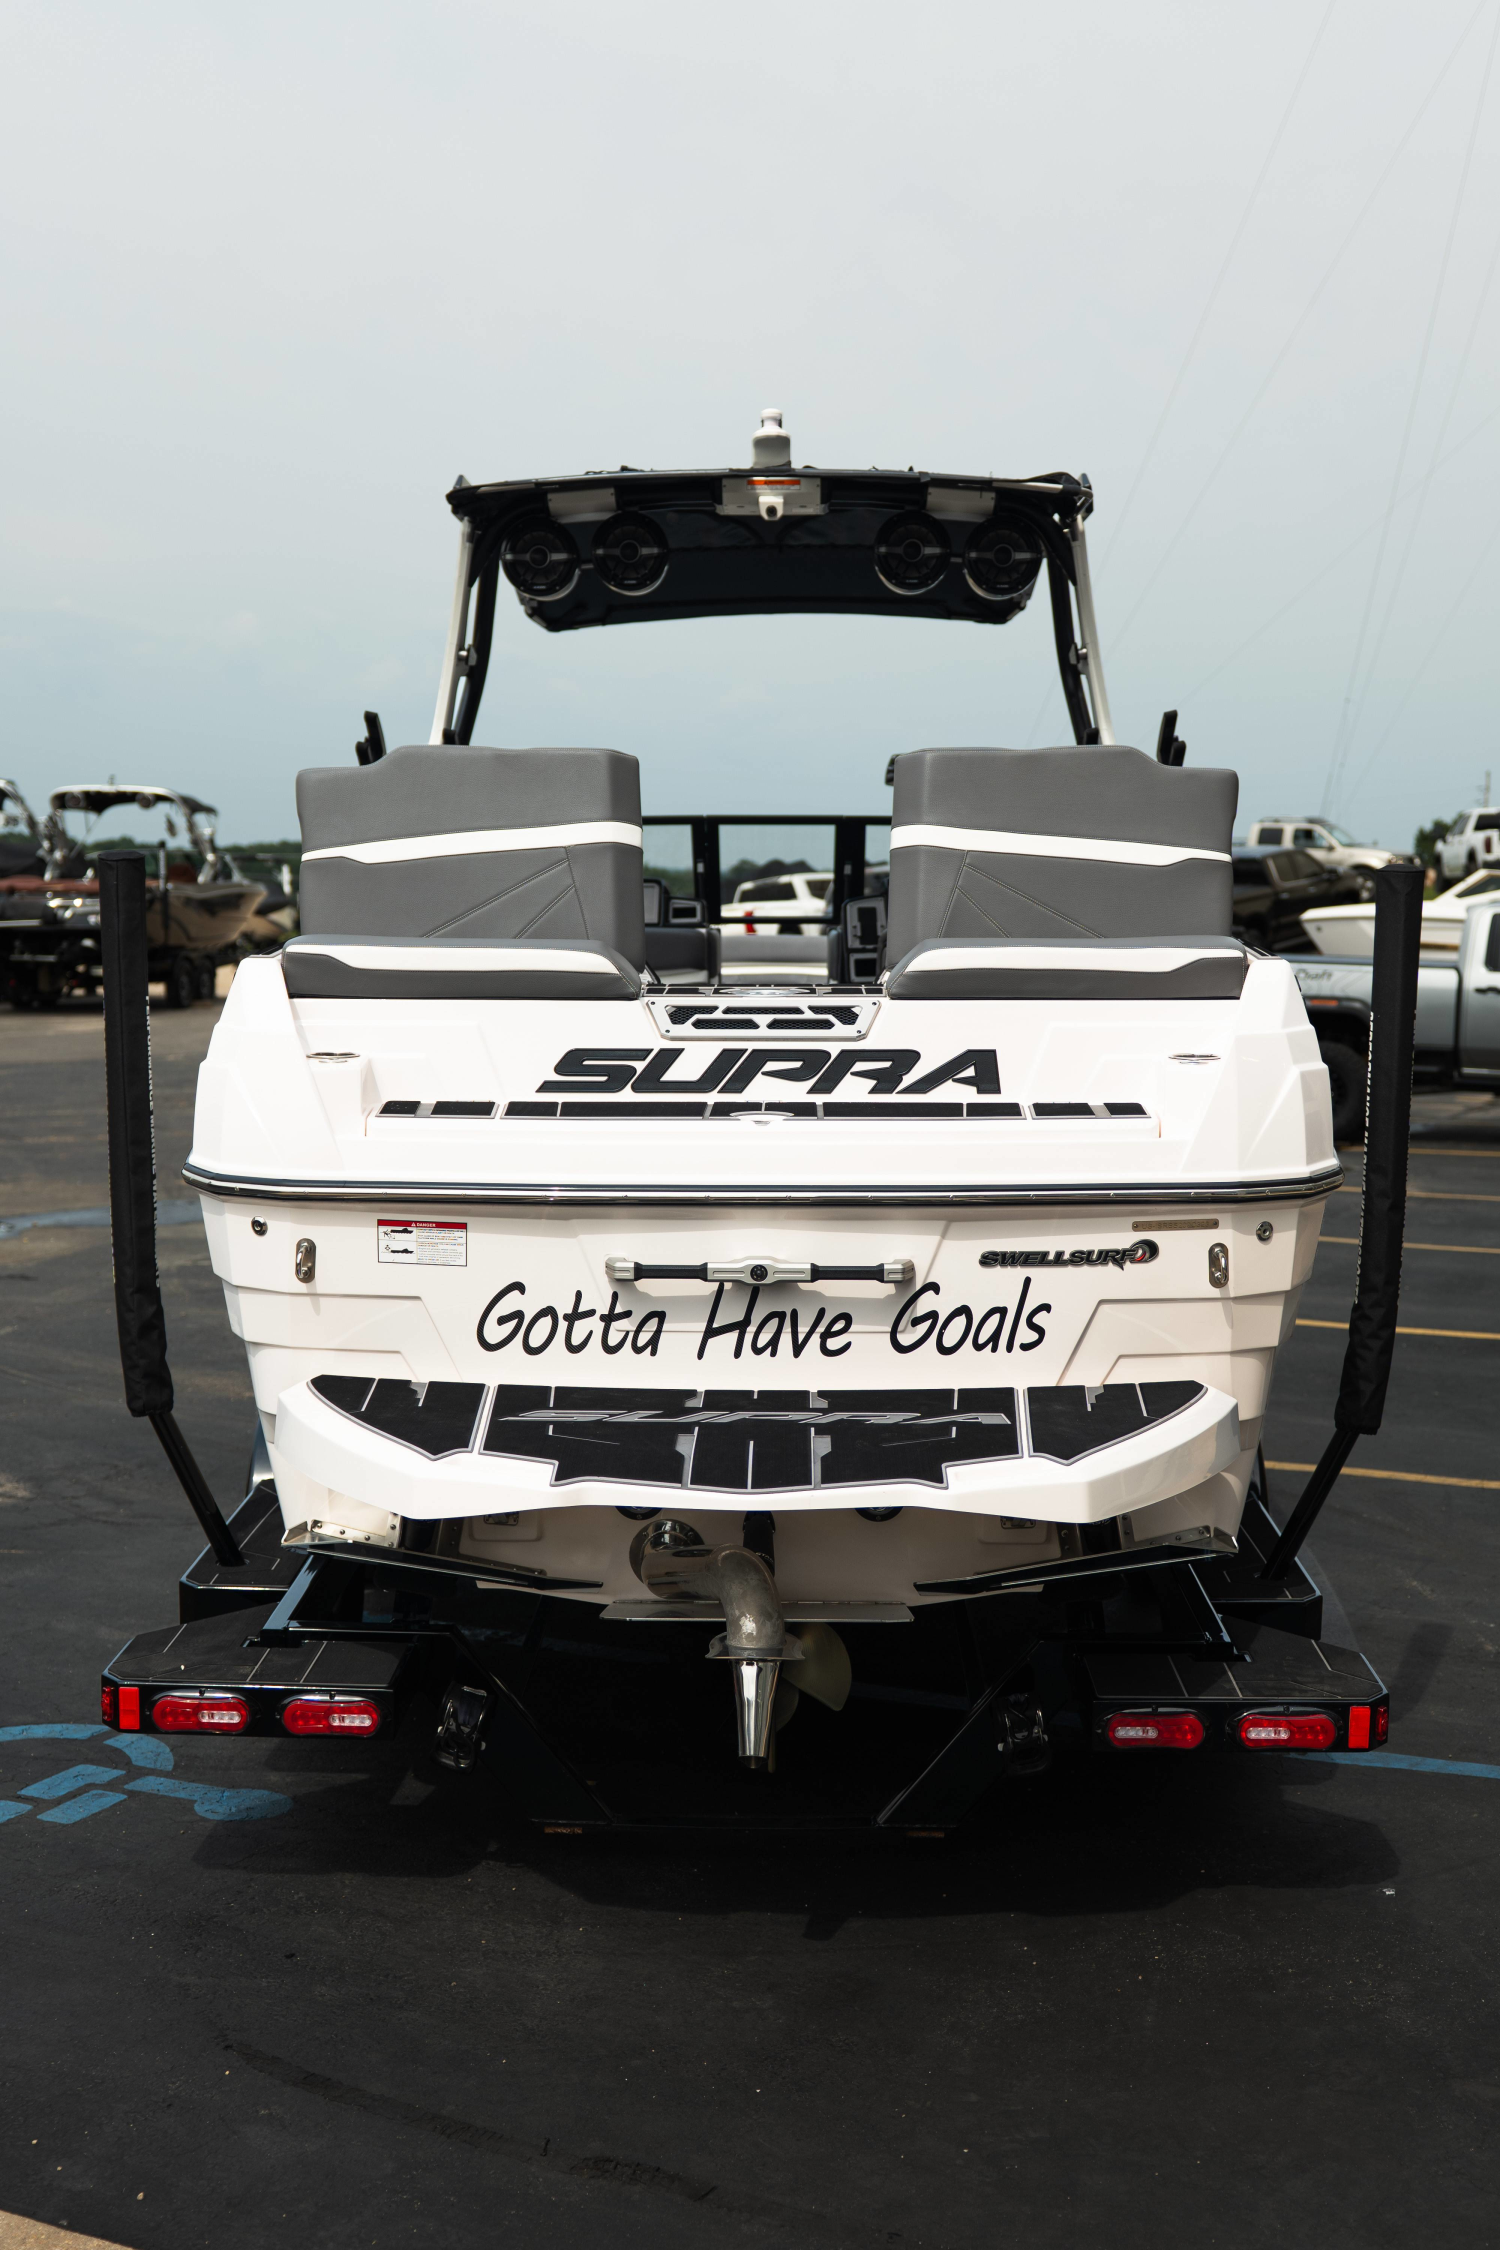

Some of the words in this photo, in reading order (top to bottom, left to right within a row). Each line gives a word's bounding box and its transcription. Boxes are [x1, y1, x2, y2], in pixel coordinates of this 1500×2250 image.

[535, 1047, 1002, 1095] SUPRA
[979, 1246, 1140, 1271] SWELLSURF
[476, 1280, 667, 1357] Gotta
[696, 1281, 854, 1360] Have
[889, 1275, 1053, 1356] Goals
[499, 1409, 1012, 1425] SUPRA
